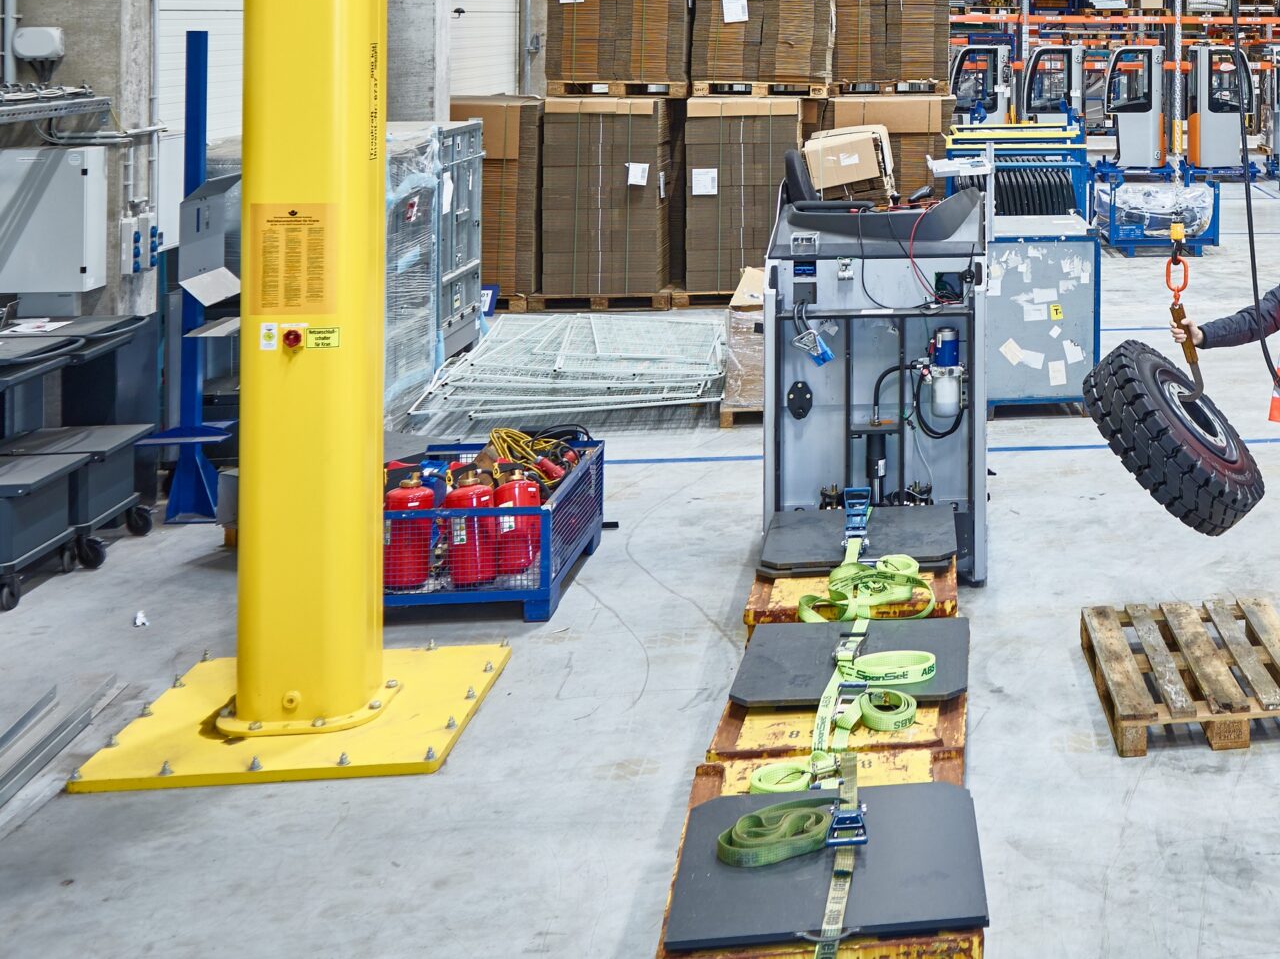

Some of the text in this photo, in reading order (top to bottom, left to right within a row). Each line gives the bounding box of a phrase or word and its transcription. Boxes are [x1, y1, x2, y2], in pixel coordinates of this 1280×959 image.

[855, 663, 935, 682] SpanSet ABS
[893, 716, 914, 730] ABS
